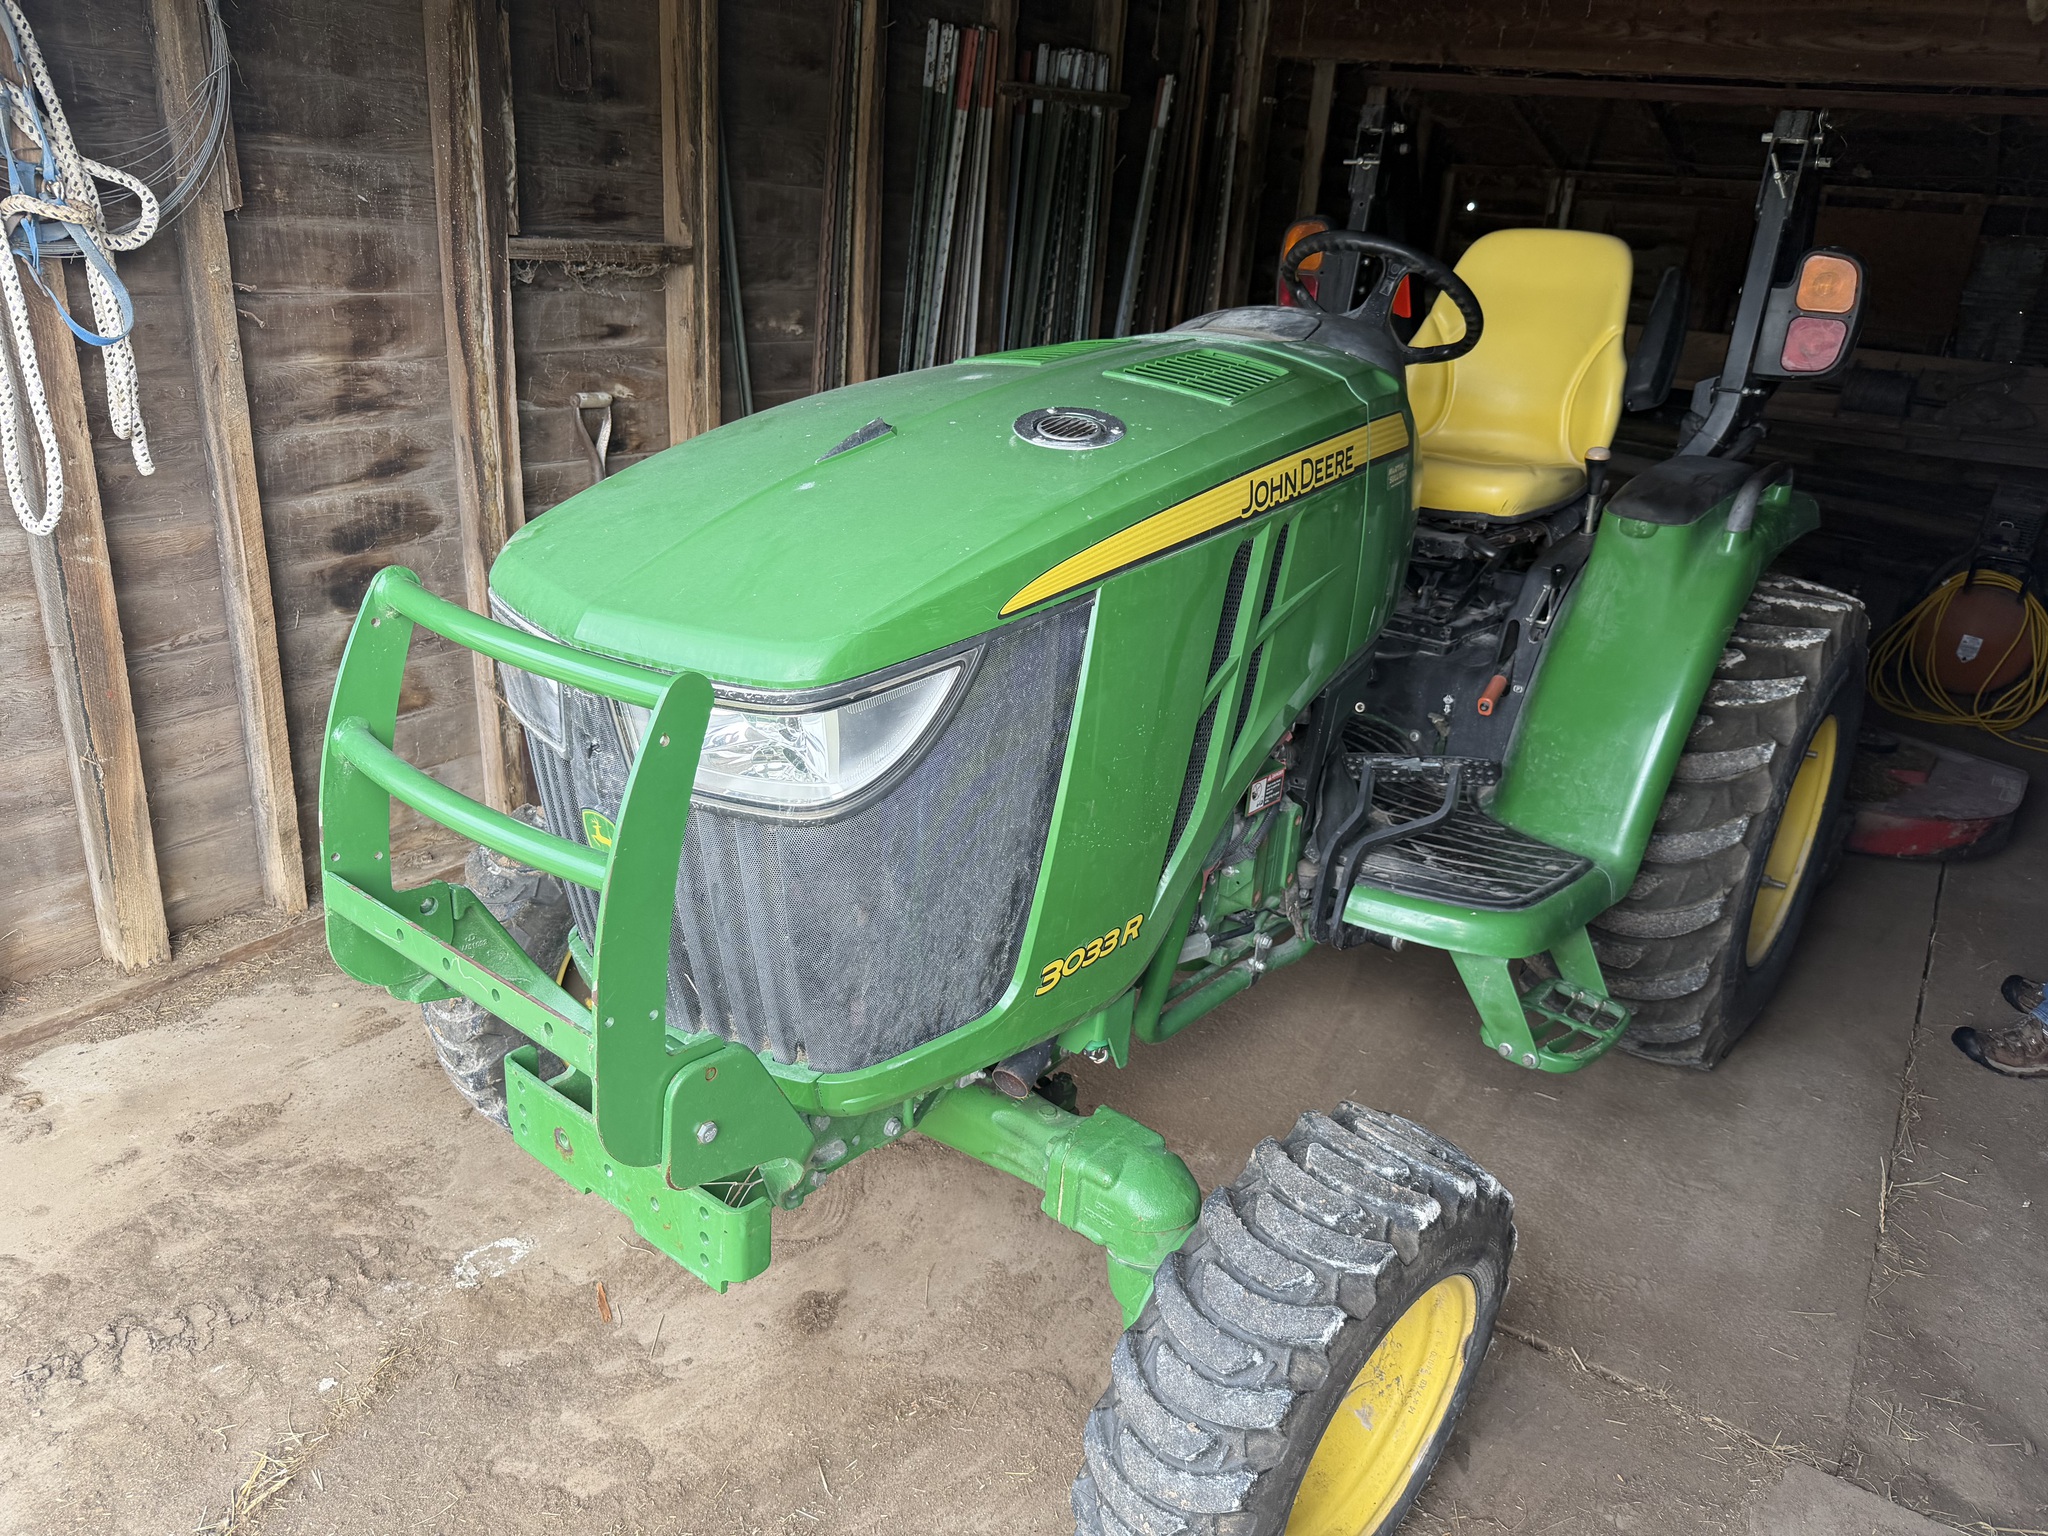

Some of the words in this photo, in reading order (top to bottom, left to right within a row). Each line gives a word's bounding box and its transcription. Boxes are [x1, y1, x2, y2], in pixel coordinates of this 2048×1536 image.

[1241, 468, 1297, 515] JOHN
[1300, 446, 1354, 489] DEERE
[1034, 913, 1144, 997] 3033R
